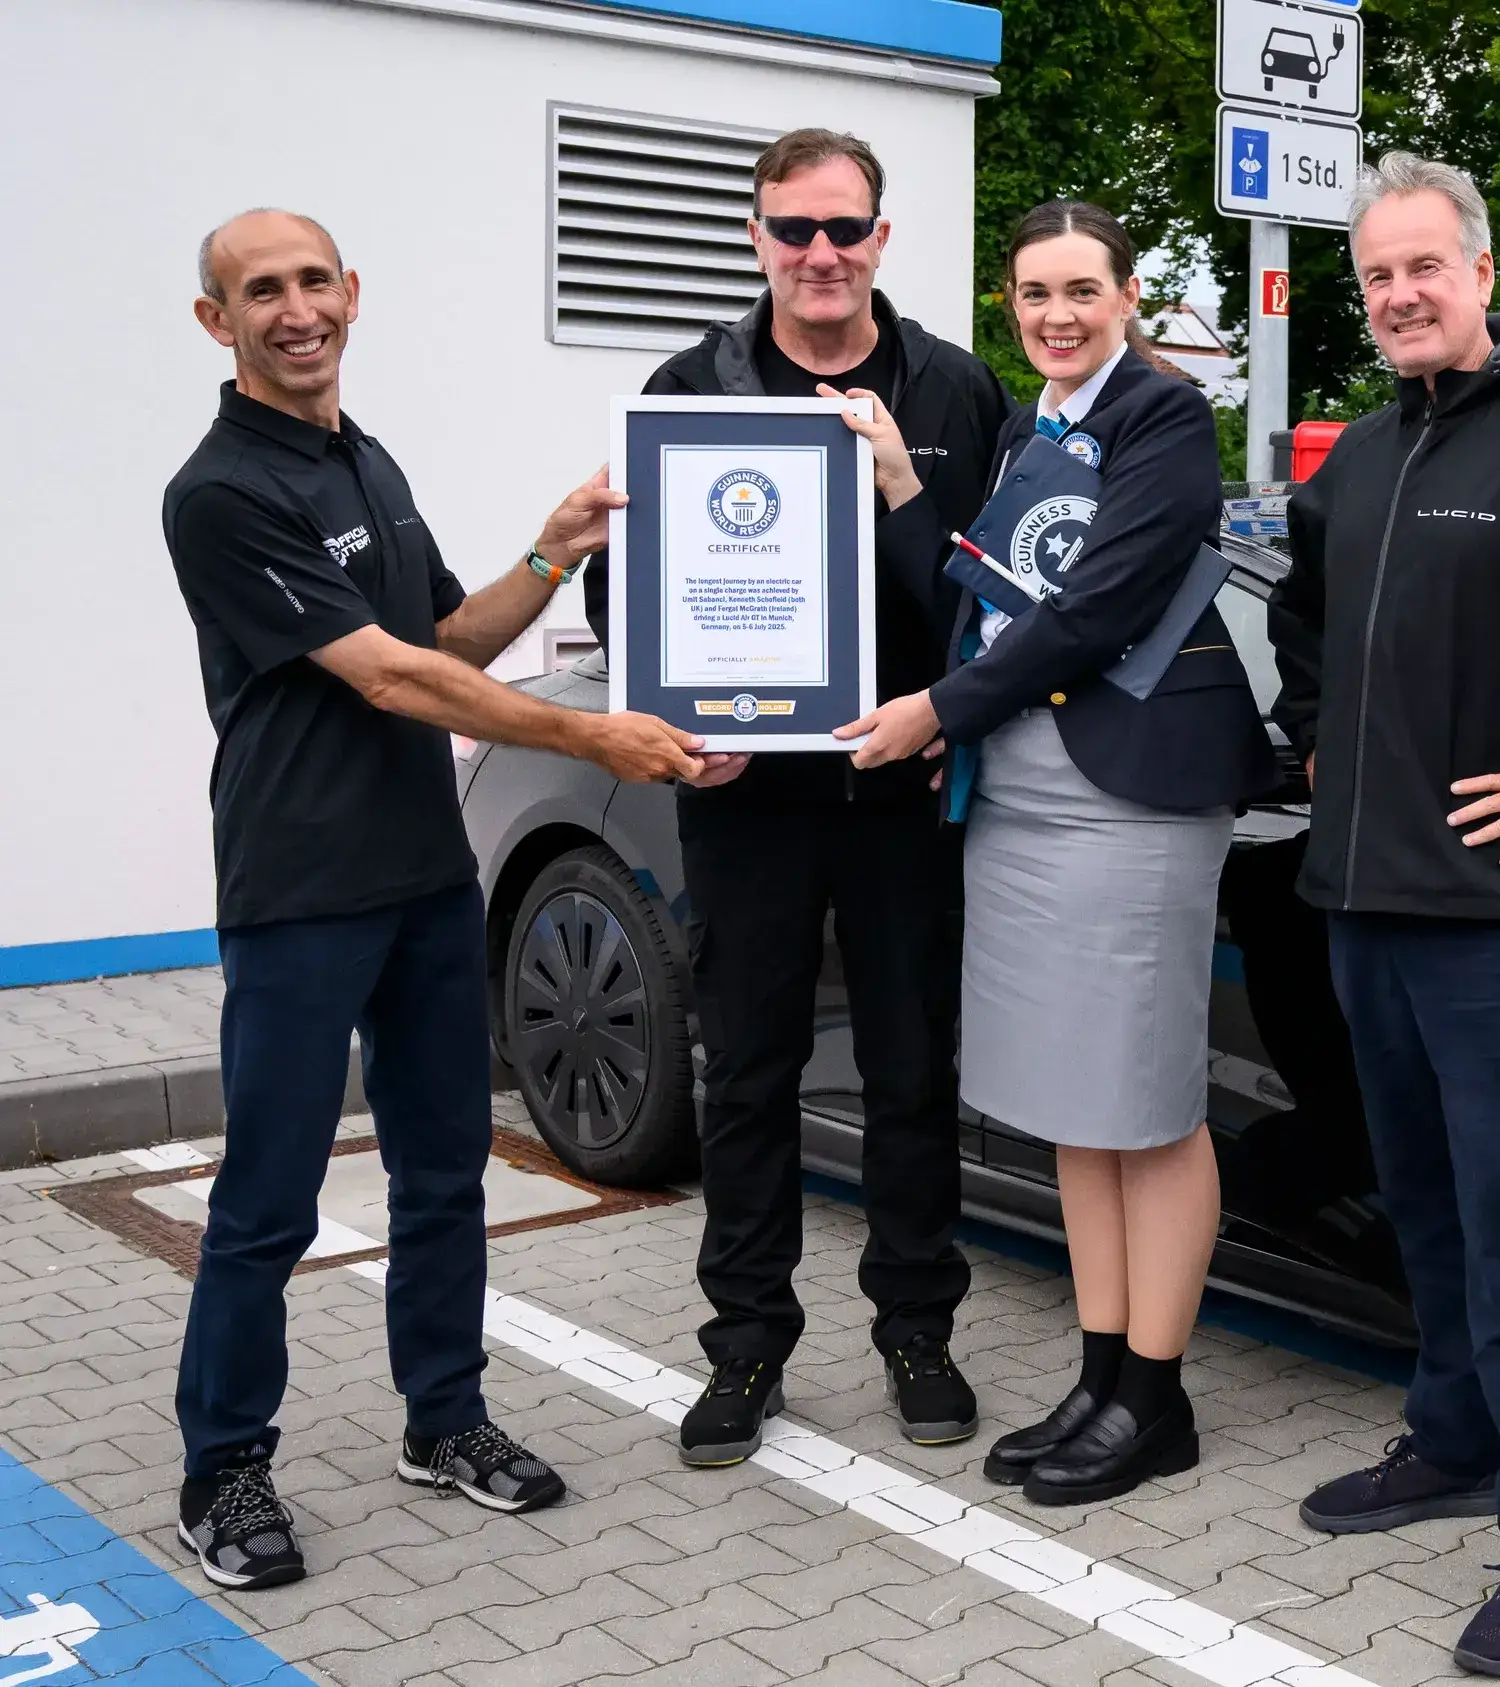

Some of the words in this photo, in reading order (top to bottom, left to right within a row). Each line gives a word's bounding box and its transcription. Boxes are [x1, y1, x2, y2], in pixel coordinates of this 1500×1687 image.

[1282, 153, 1290, 183] 1
[1297, 155, 1343, 190] Std.
[1245, 177, 1254, 191] P
[1065, 435, 1096, 448] GUINNESS
[907, 447, 948, 456] UCID
[717, 472, 771, 491] GUINNESS
[711, 499, 736, 532] WORLD
[740, 499, 776, 535] RECORDS
[1417, 509, 1496, 521] LUCID
[1018, 503, 1072, 574] GUINNESS
[707, 544, 781, 553] CERTIFICATE
[264, 567, 286, 588] GREEN
[698, 578, 722, 586] longest
[704, 587, 723, 595] single
[724, 587, 747, 595] charge
[284, 589, 305, 614] GALVIN
[690, 605, 703, 613] UK)
[718, 605, 738, 613] Fergal
[769, 605, 797, 613] (Ireland)
[693, 614, 715, 622] driving
[768, 614, 795, 622] Munich,
[701, 623, 731, 631] Germany,
[754, 623, 766, 631] July
